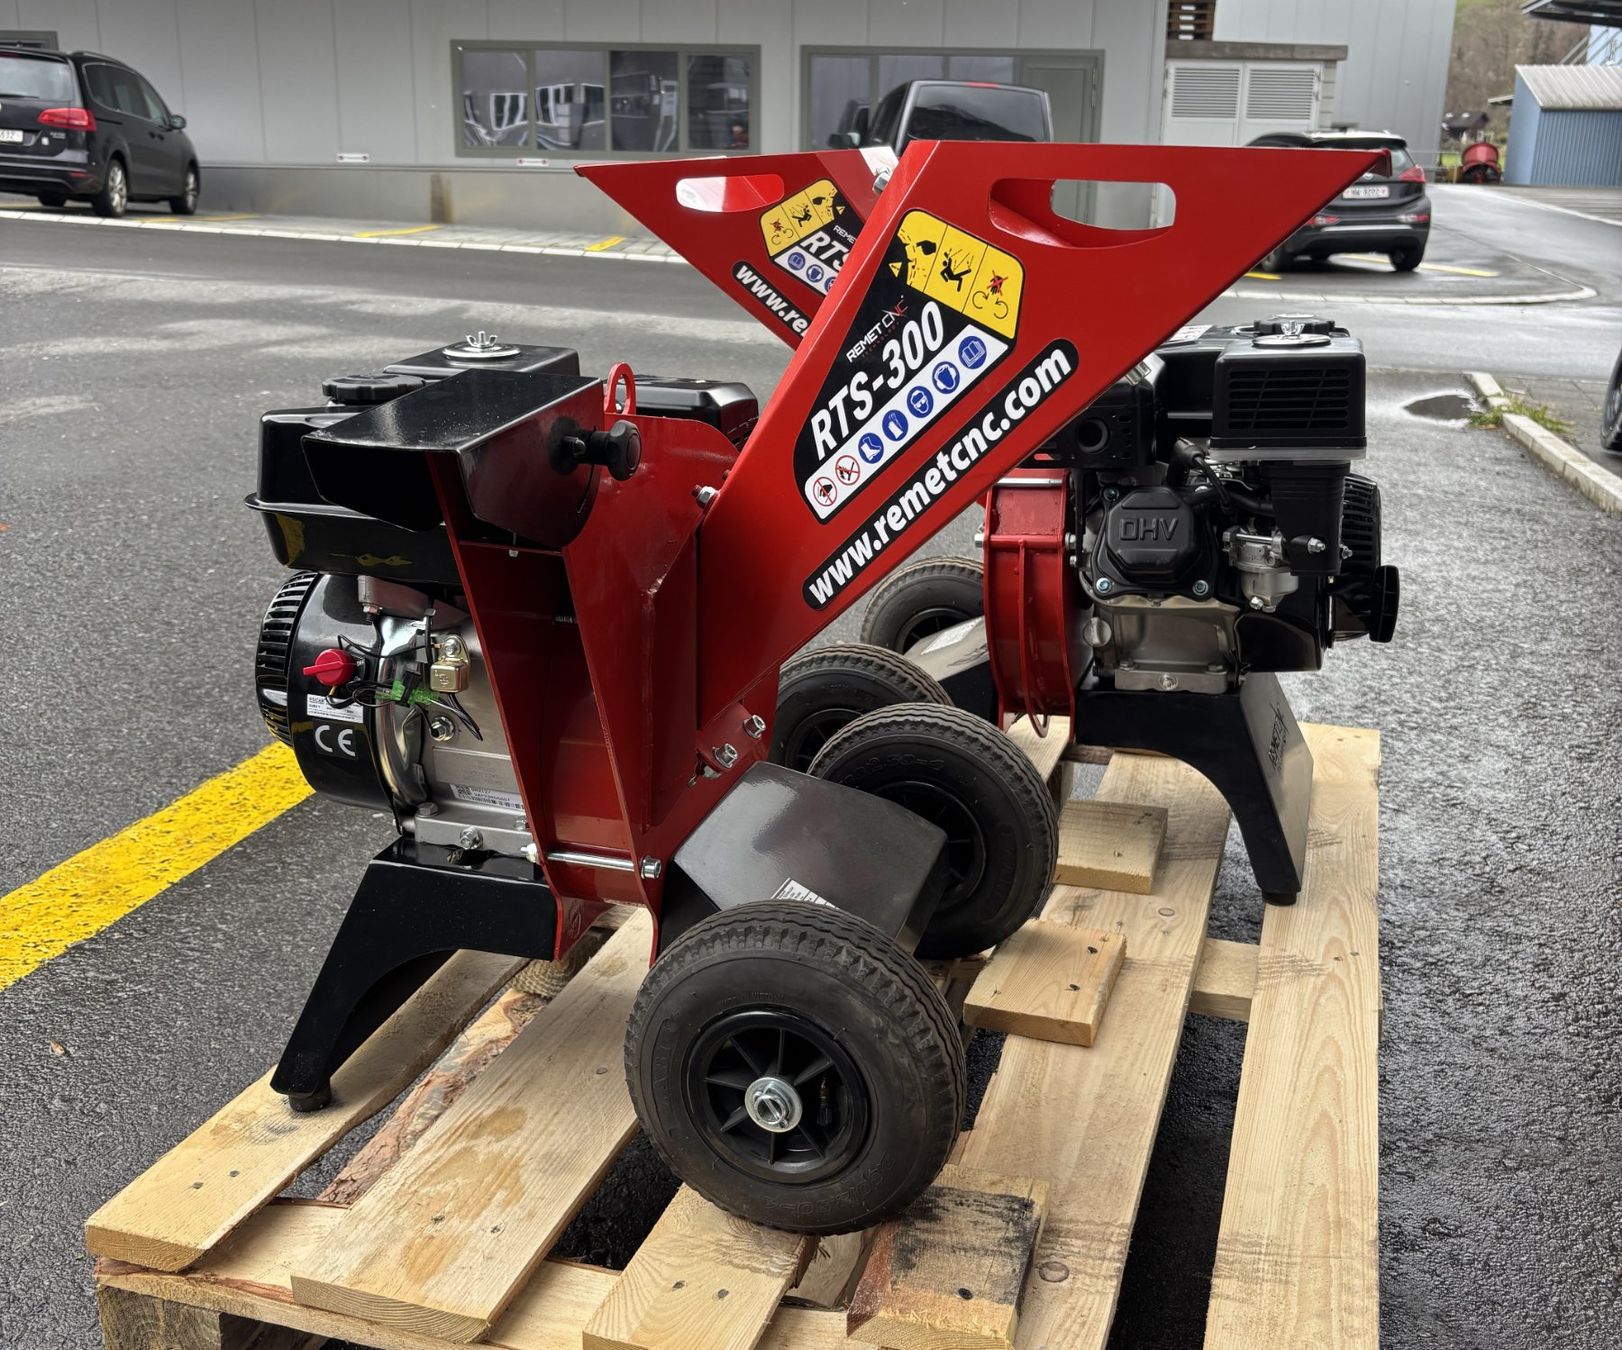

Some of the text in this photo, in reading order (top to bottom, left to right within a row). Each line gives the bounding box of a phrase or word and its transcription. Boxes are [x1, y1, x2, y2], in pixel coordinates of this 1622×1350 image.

[736, 265, 809, 338] www.re
[846, 301, 909, 363] REMET CNC
[811, 300, 944, 461] RTS-300
[808, 348, 1072, 605] www.remetcnc.com
[314, 724, 356, 757] CE
